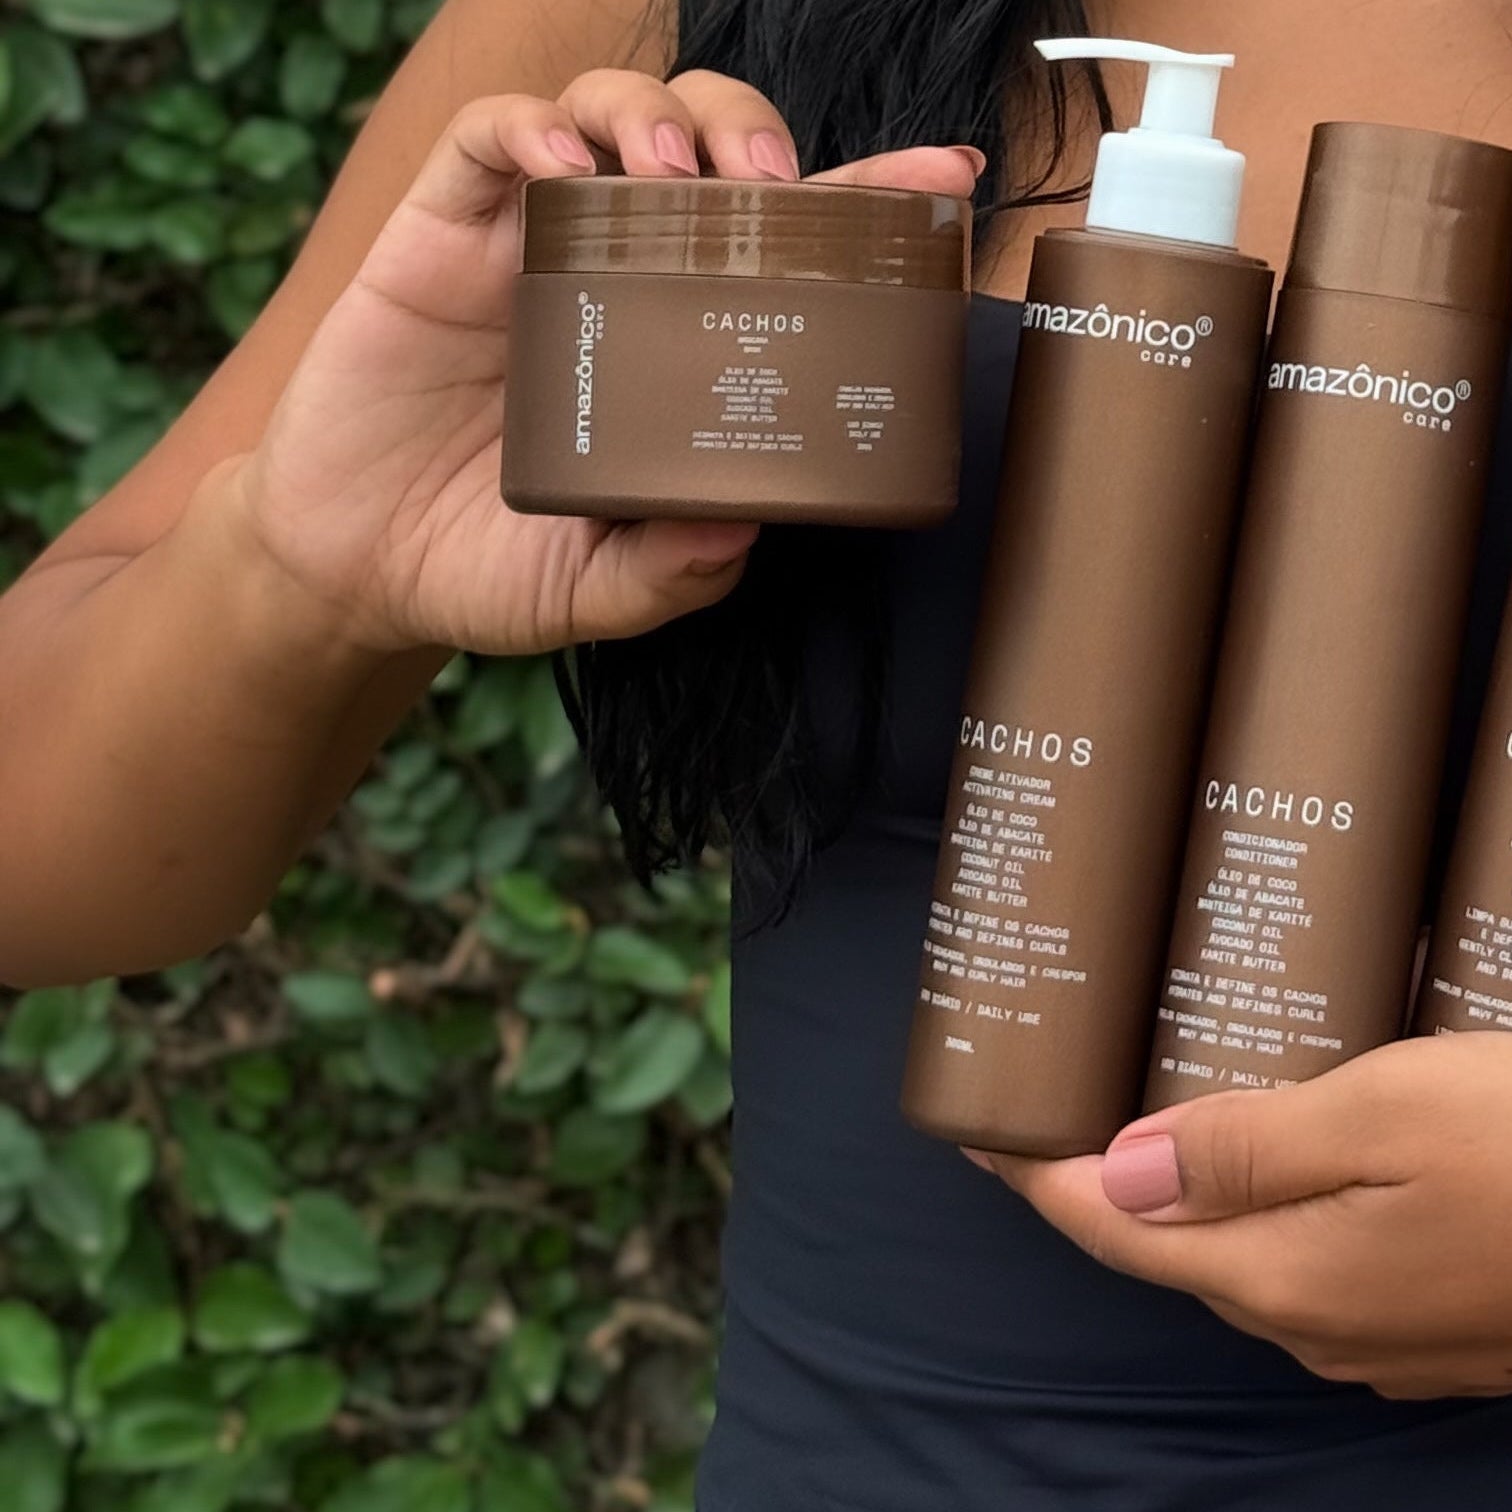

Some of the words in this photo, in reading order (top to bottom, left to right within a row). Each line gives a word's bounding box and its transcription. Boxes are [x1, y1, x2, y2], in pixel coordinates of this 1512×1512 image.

[703, 312, 805, 332] CACHOS
[1140, 349, 1192, 368] care
[1403, 411, 1451, 431] care
[960, 716, 1093, 767] CACHOS
[998, 772, 1051, 790] ATIVADOR
[1020, 793, 1056, 807] CREAM
[1205, 780, 1354, 831] CACHOS
[1009, 812, 1037, 828] COCO
[997, 827, 1045, 845] ABACATE
[1222, 830, 1308, 853] CONDICIONADOR
[1004, 861, 1025, 874] OIL
[1224, 847, 1298, 869] CONDITIONER
[1002, 877, 1022, 890] OIL
[1217, 866, 1242, 883] ÓLEO
[1267, 877, 1297, 892] COCO
[987, 889, 1028, 907] BUTTER
[1234, 888, 1249, 900] DE
[1254, 892, 1305, 910] ABACATE
[1248, 906, 1263, 919] DE
[1268, 909, 1313, 928] KARITÉ
[1025, 923, 1070, 939] CACHOS
[1262, 926, 1284, 940] OIL
[977, 931, 1024, 949] DEFINES
[1029, 940, 1067, 956] CURLS
[1208, 933, 1253, 952] AVOCADO
[1259, 941, 1280, 956] OIL
[1200, 948, 1237, 965] KARITE
[1242, 956, 1286, 974] BUTTER
[1475, 960, 1497, 976] AND
[1216, 977, 1256, 995] DEFINE
[1262, 984, 1277, 998] OS
[1284, 989, 1328, 1007] CACHOS
[977, 1004, 1013, 1021] DAILY
[1231, 996, 1282, 1016] DEFINES
[1287, 1006, 1325, 1023] CURLS
[1231, 1072, 1269, 1088] DAILY
